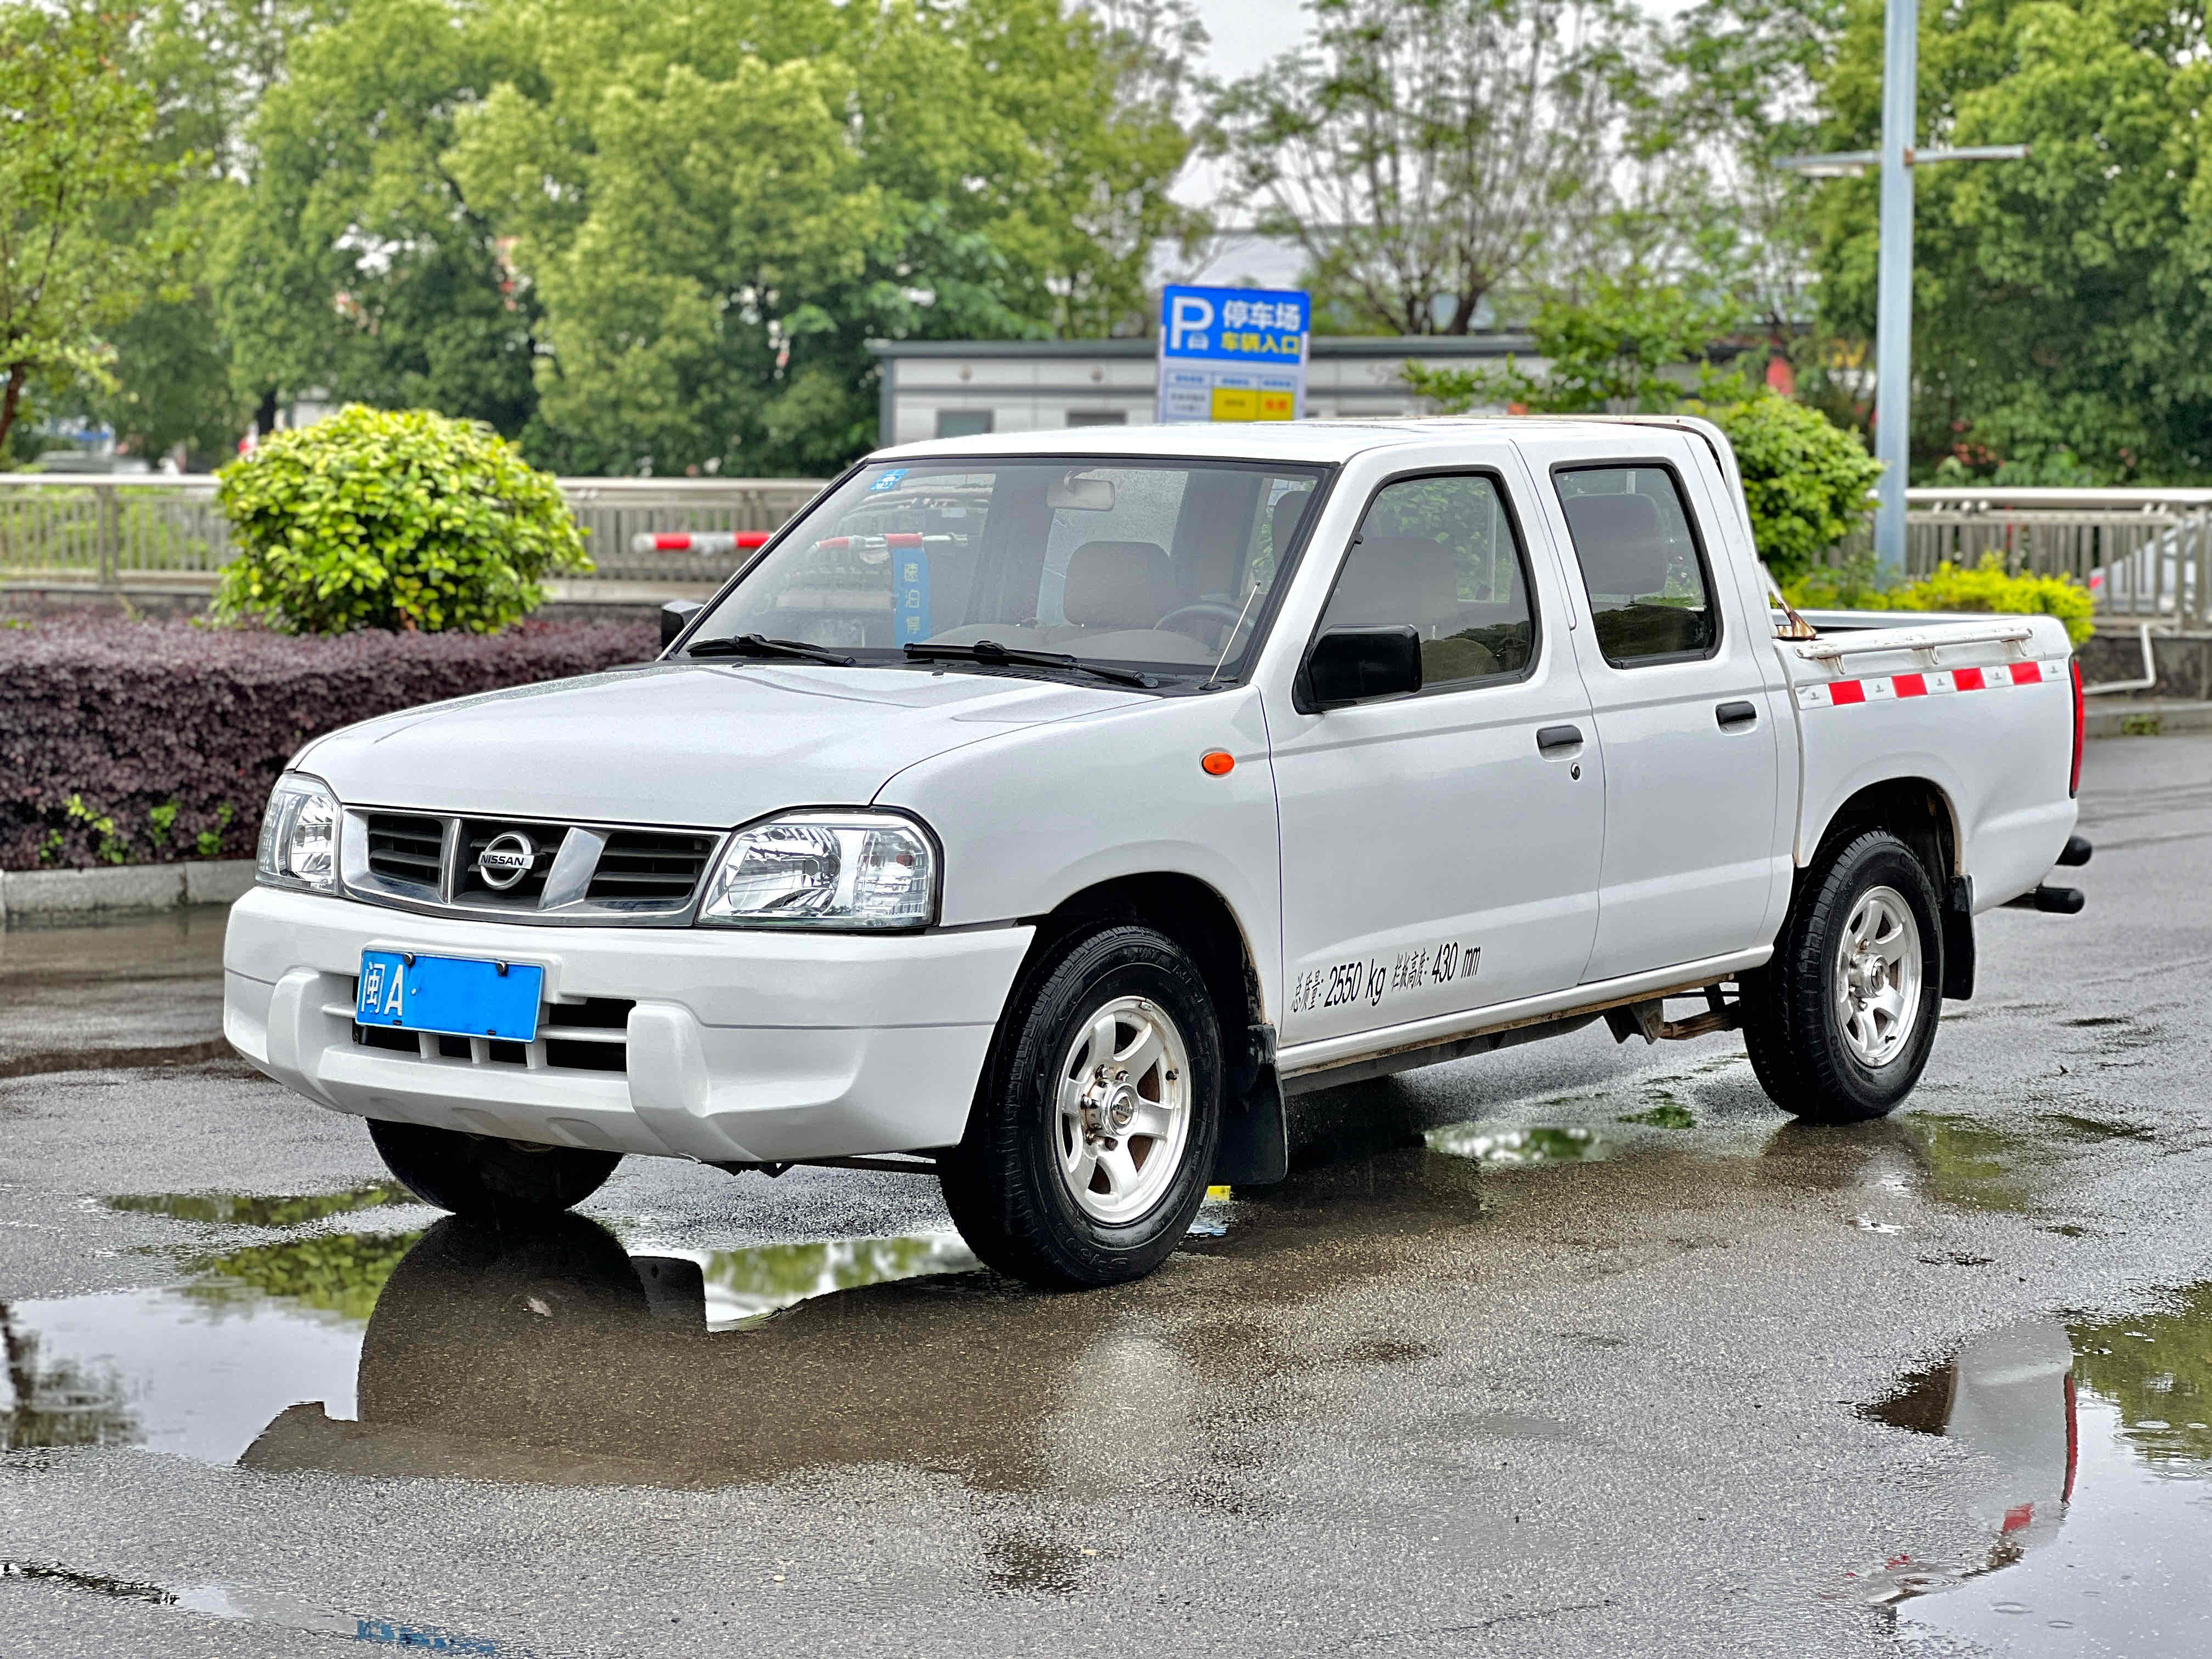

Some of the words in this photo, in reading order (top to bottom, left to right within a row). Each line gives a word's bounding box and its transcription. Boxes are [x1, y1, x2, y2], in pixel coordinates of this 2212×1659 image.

[1170, 296, 1214, 350] P
[1222, 300, 1301, 331] 停车场
[1220, 331, 1300, 354] 车辆入口
[481, 854, 524, 866] NISSAN
[1324, 961, 1362, 1008] 2550
[1365, 958, 1387, 1006] kg
[1431, 942, 1458, 984] 430
[1461, 946, 1481, 979] mm
